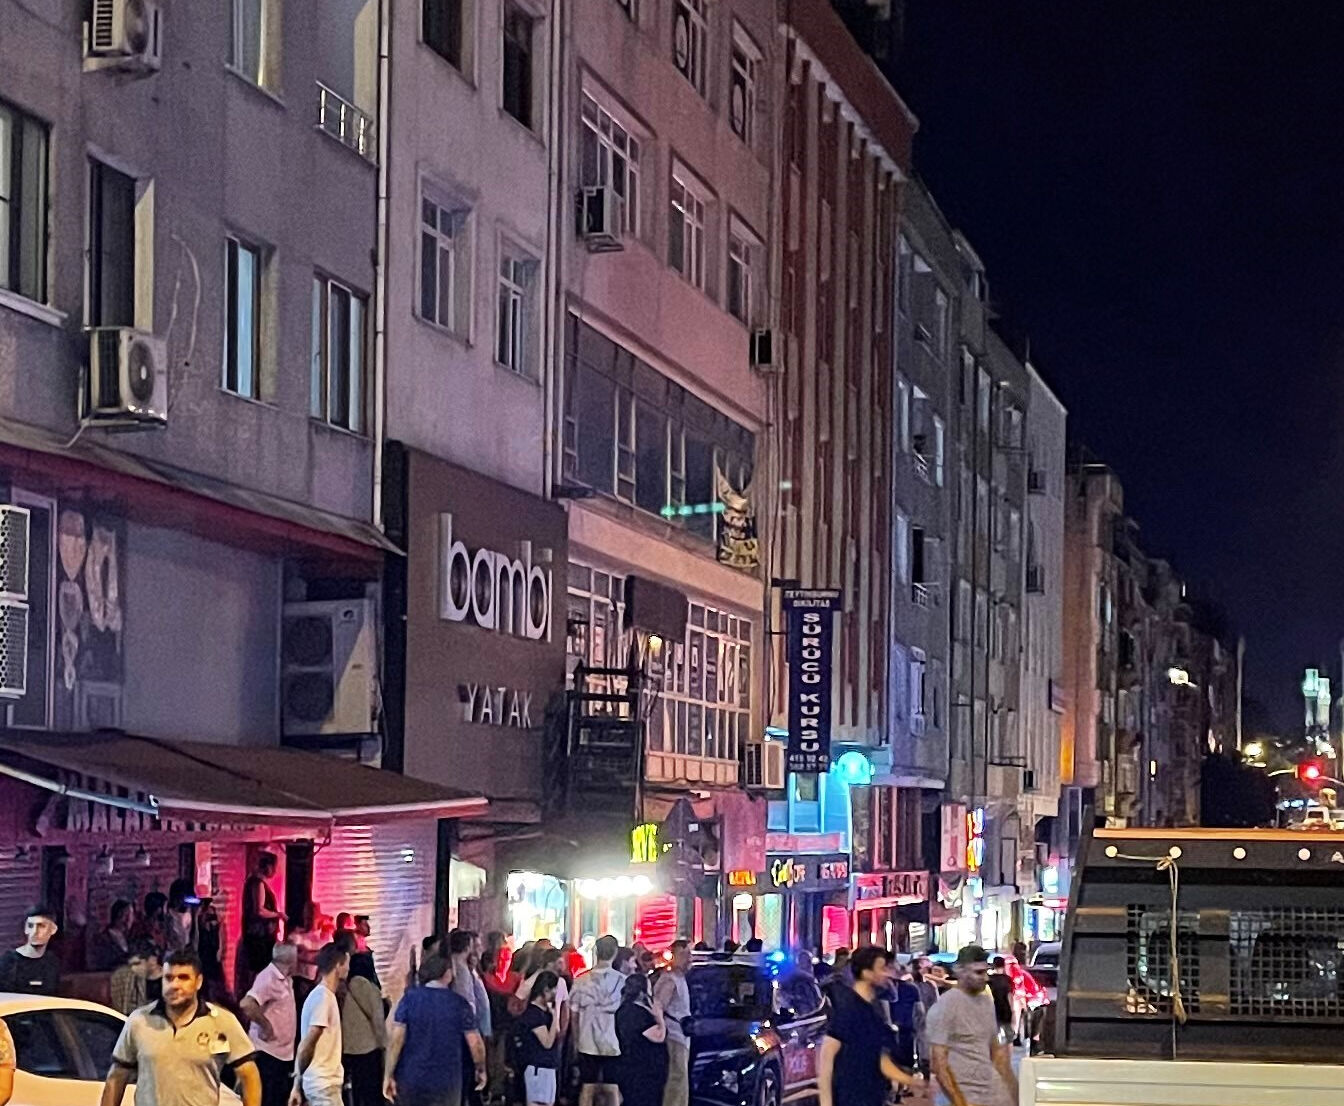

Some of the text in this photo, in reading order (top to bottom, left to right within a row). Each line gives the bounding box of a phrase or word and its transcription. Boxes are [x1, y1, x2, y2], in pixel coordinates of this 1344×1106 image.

[439, 512, 553, 643] bambi
[463, 682, 533, 729] YATAK
[799, 693, 820, 752] KURSU
